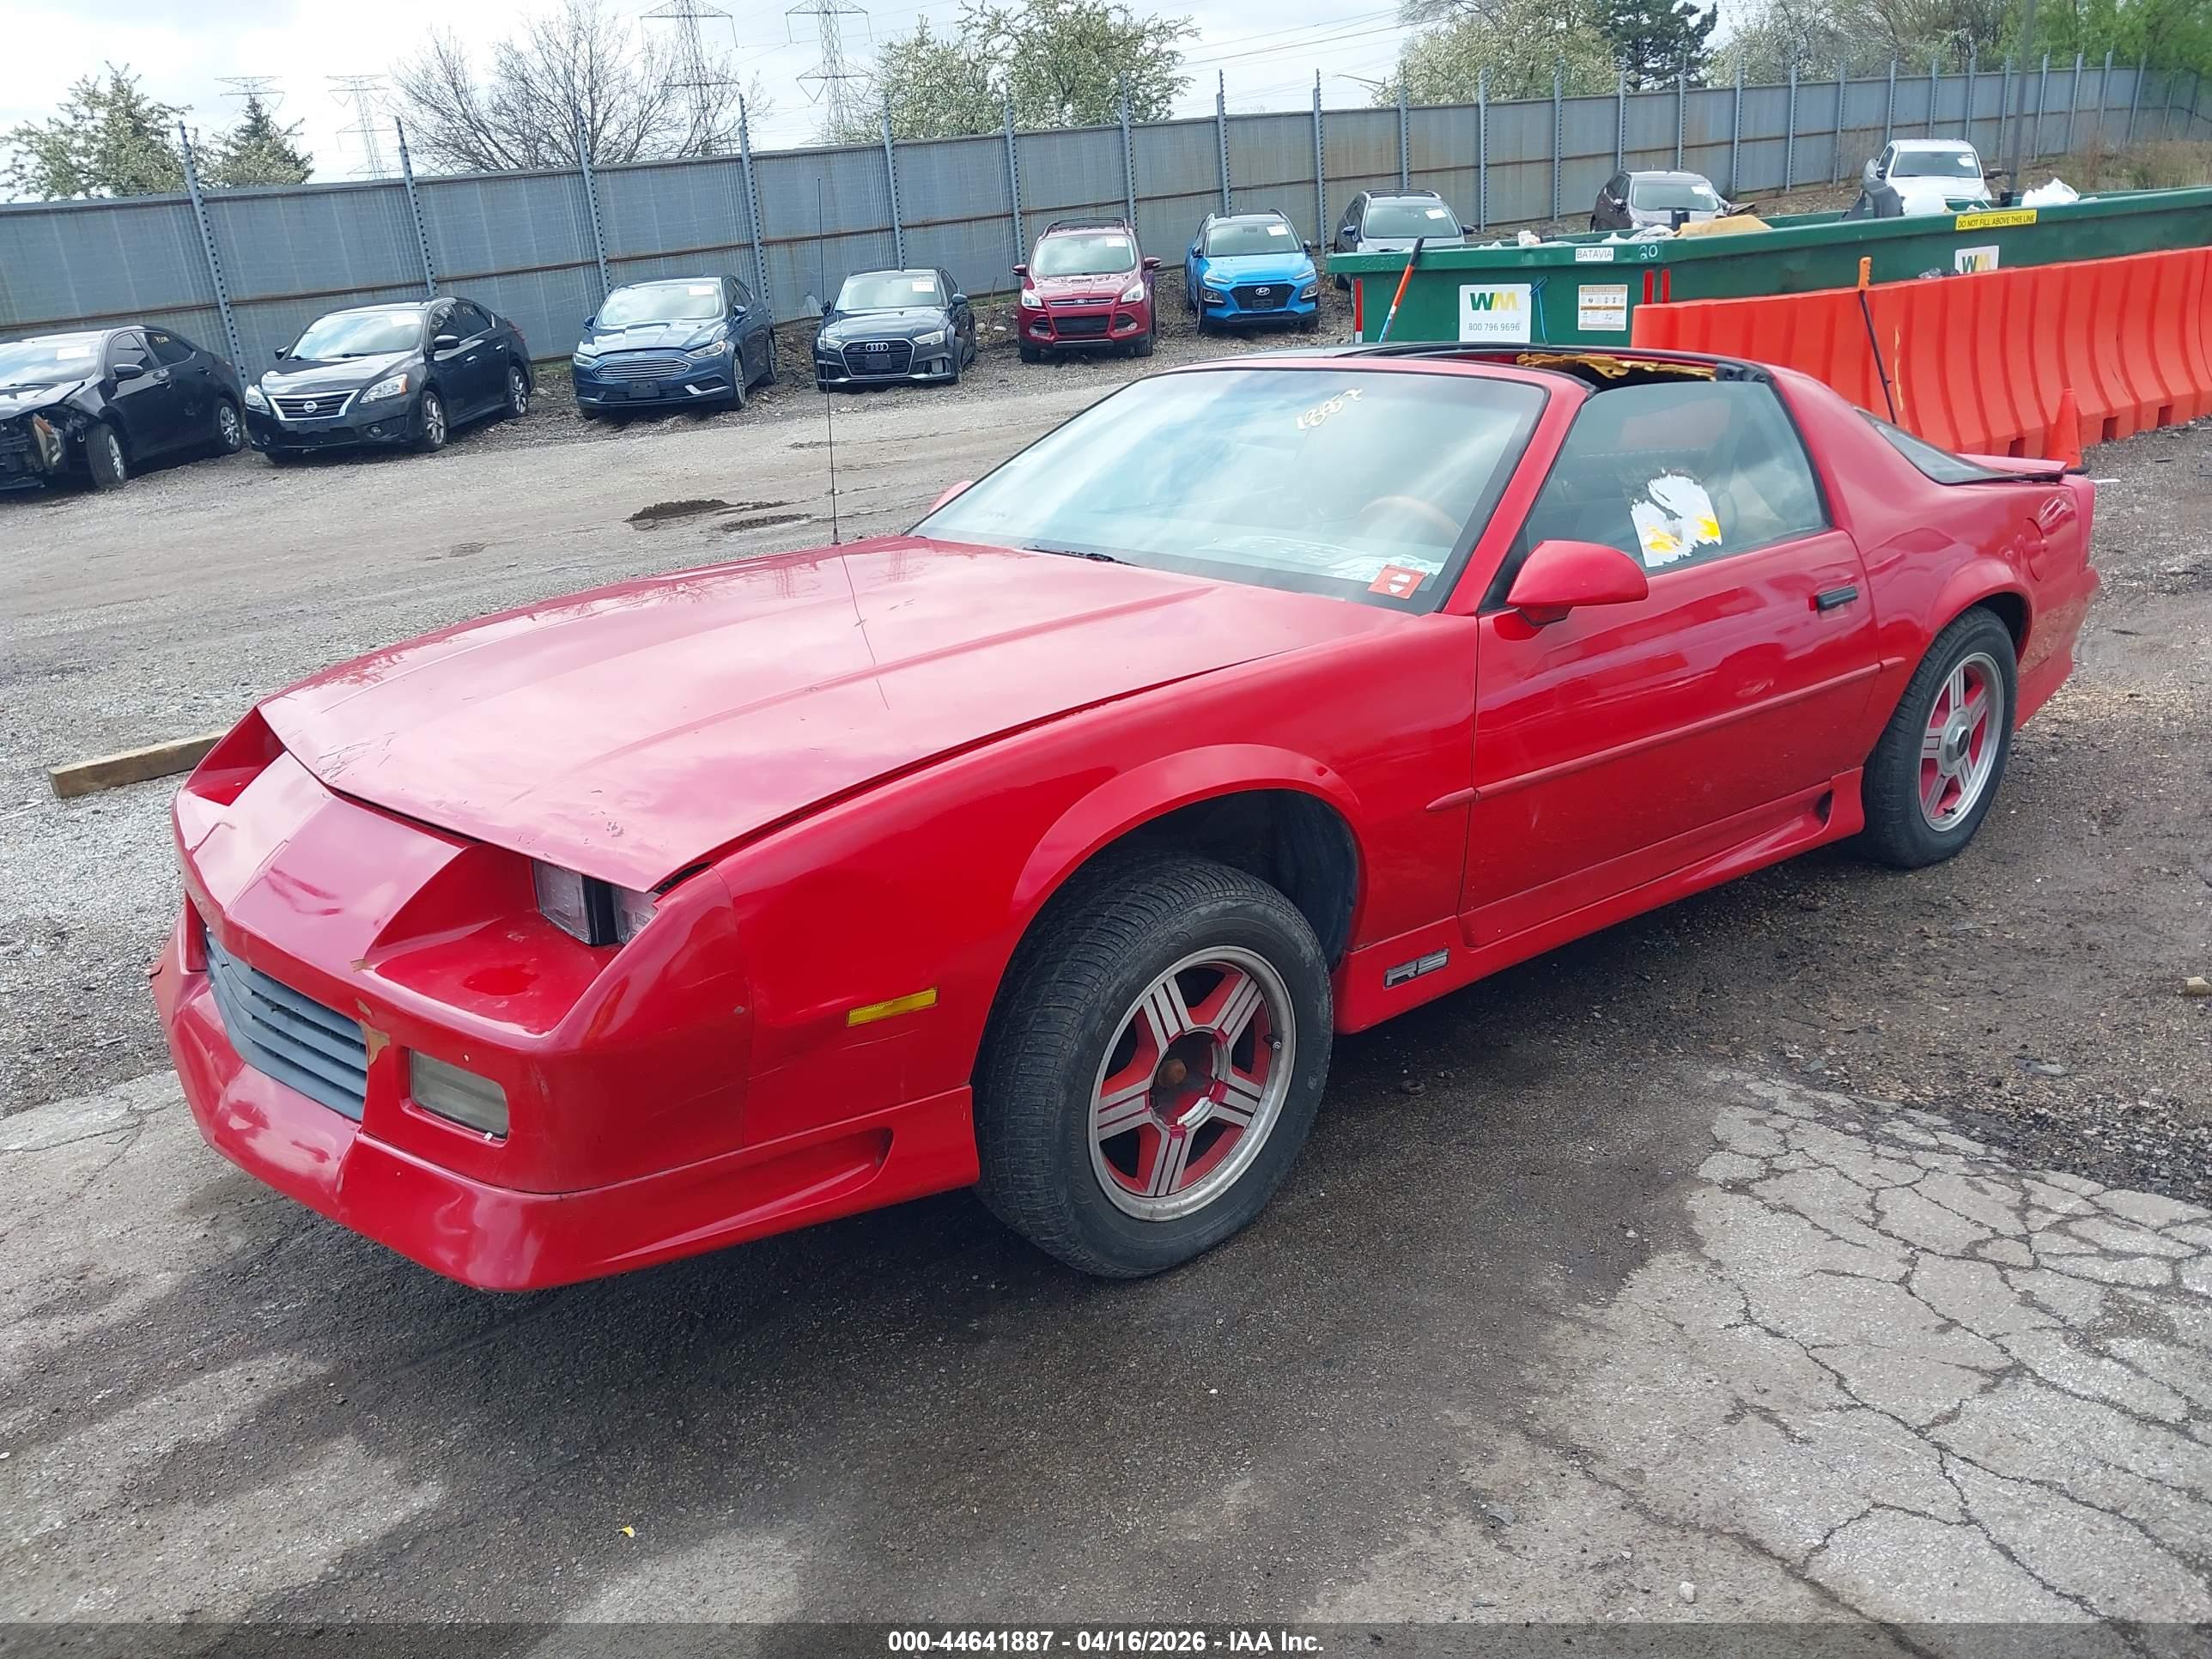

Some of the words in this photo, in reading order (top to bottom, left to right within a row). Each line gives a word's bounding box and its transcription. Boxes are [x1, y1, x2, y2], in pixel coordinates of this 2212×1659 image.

[1958, 220, 1966, 228] DO
[1967, 219, 1978, 228] NOT
[1979, 217, 1990, 227] FILL
[1992, 216, 2010, 225] ABOVE
[2011, 215, 2022, 223] THIS
[2023, 214, 2035, 222] LINE
[1577, 249, 1613, 259] BATAVIA
[1961, 253, 1990, 274] WM
[1469, 291, 1518, 311] WM
[1468, 322, 1483, 331] 800
[1484, 322, 1498, 331] 796
[1500, 322, 1521, 331] 9696
[1385, 948, 1449, 987] RS
